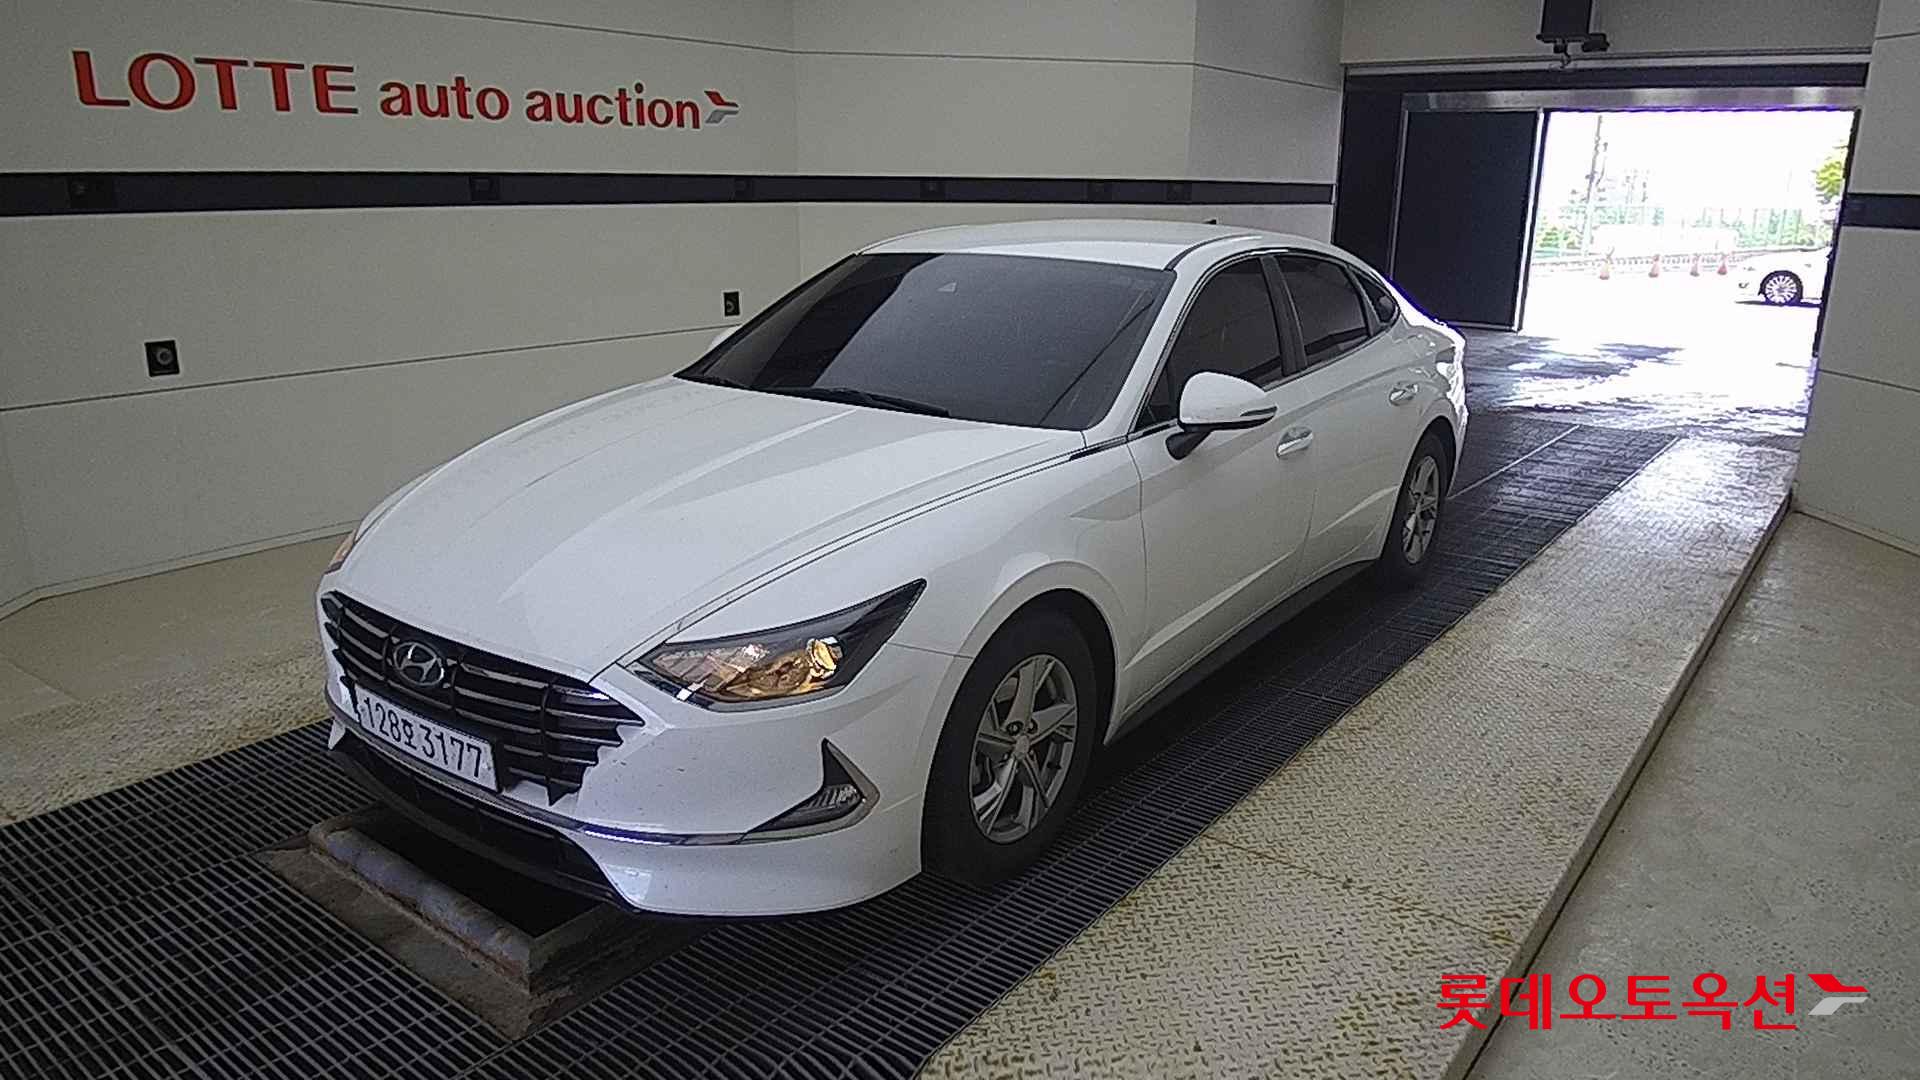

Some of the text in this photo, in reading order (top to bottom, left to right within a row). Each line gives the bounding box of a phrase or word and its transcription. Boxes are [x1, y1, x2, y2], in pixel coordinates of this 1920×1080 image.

[72, 50, 701, 129] LOTTE auto auction
